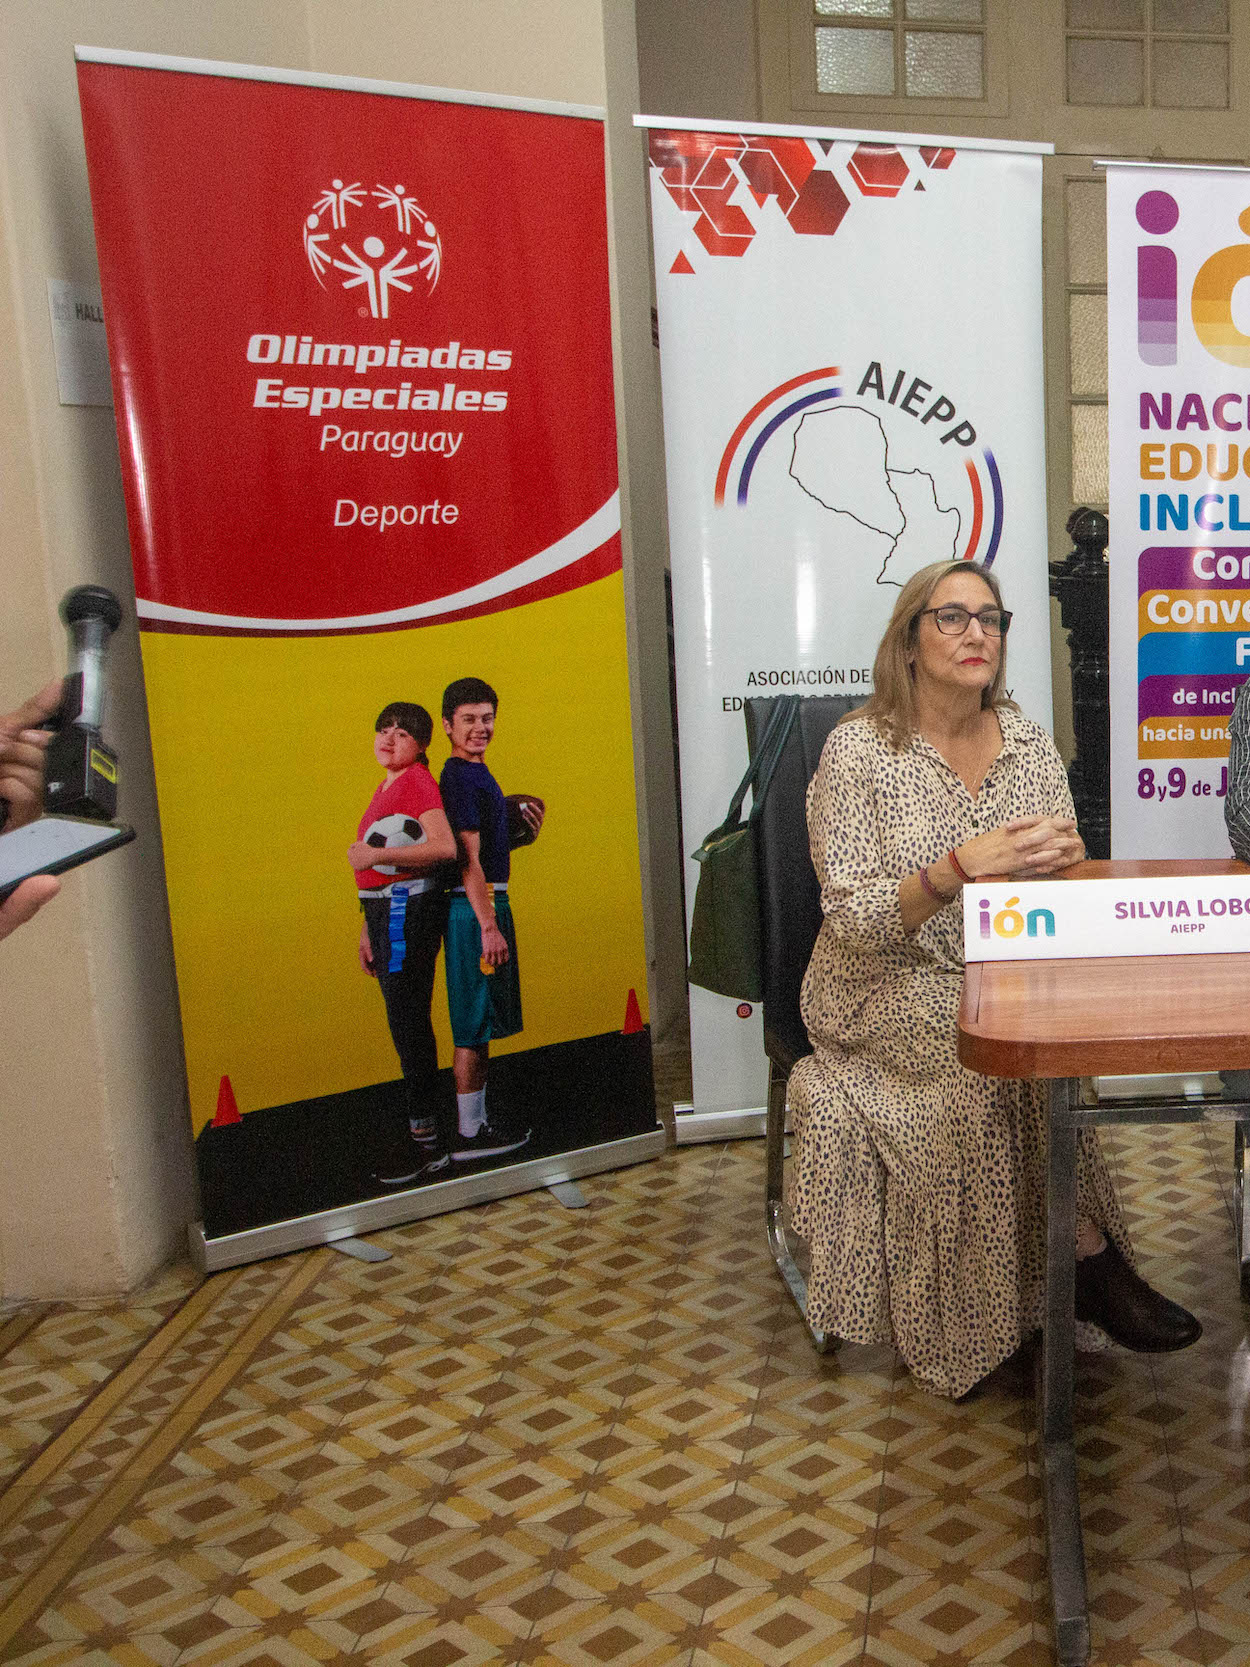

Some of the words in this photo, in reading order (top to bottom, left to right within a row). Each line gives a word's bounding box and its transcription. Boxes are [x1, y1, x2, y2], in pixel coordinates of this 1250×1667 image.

[247, 334, 513, 374] Olimpiadas
[253, 379, 509, 416] Especiales
[857, 361, 977, 448] AIEPP
[320, 425, 463, 457] Paraguay
[334, 500, 460, 532] Deporte
[747, 666, 845, 686] ASOCIACIÓN
[850, 669, 871, 684] DE
[1172, 688, 1198, 704] de
[1142, 724, 1195, 741] hacia
[1192, 780, 1211, 797] de
[978, 896, 1056, 939] ión
[1115, 899, 1191, 920] SILVIA
[1170, 923, 1206, 934] AIEPP
